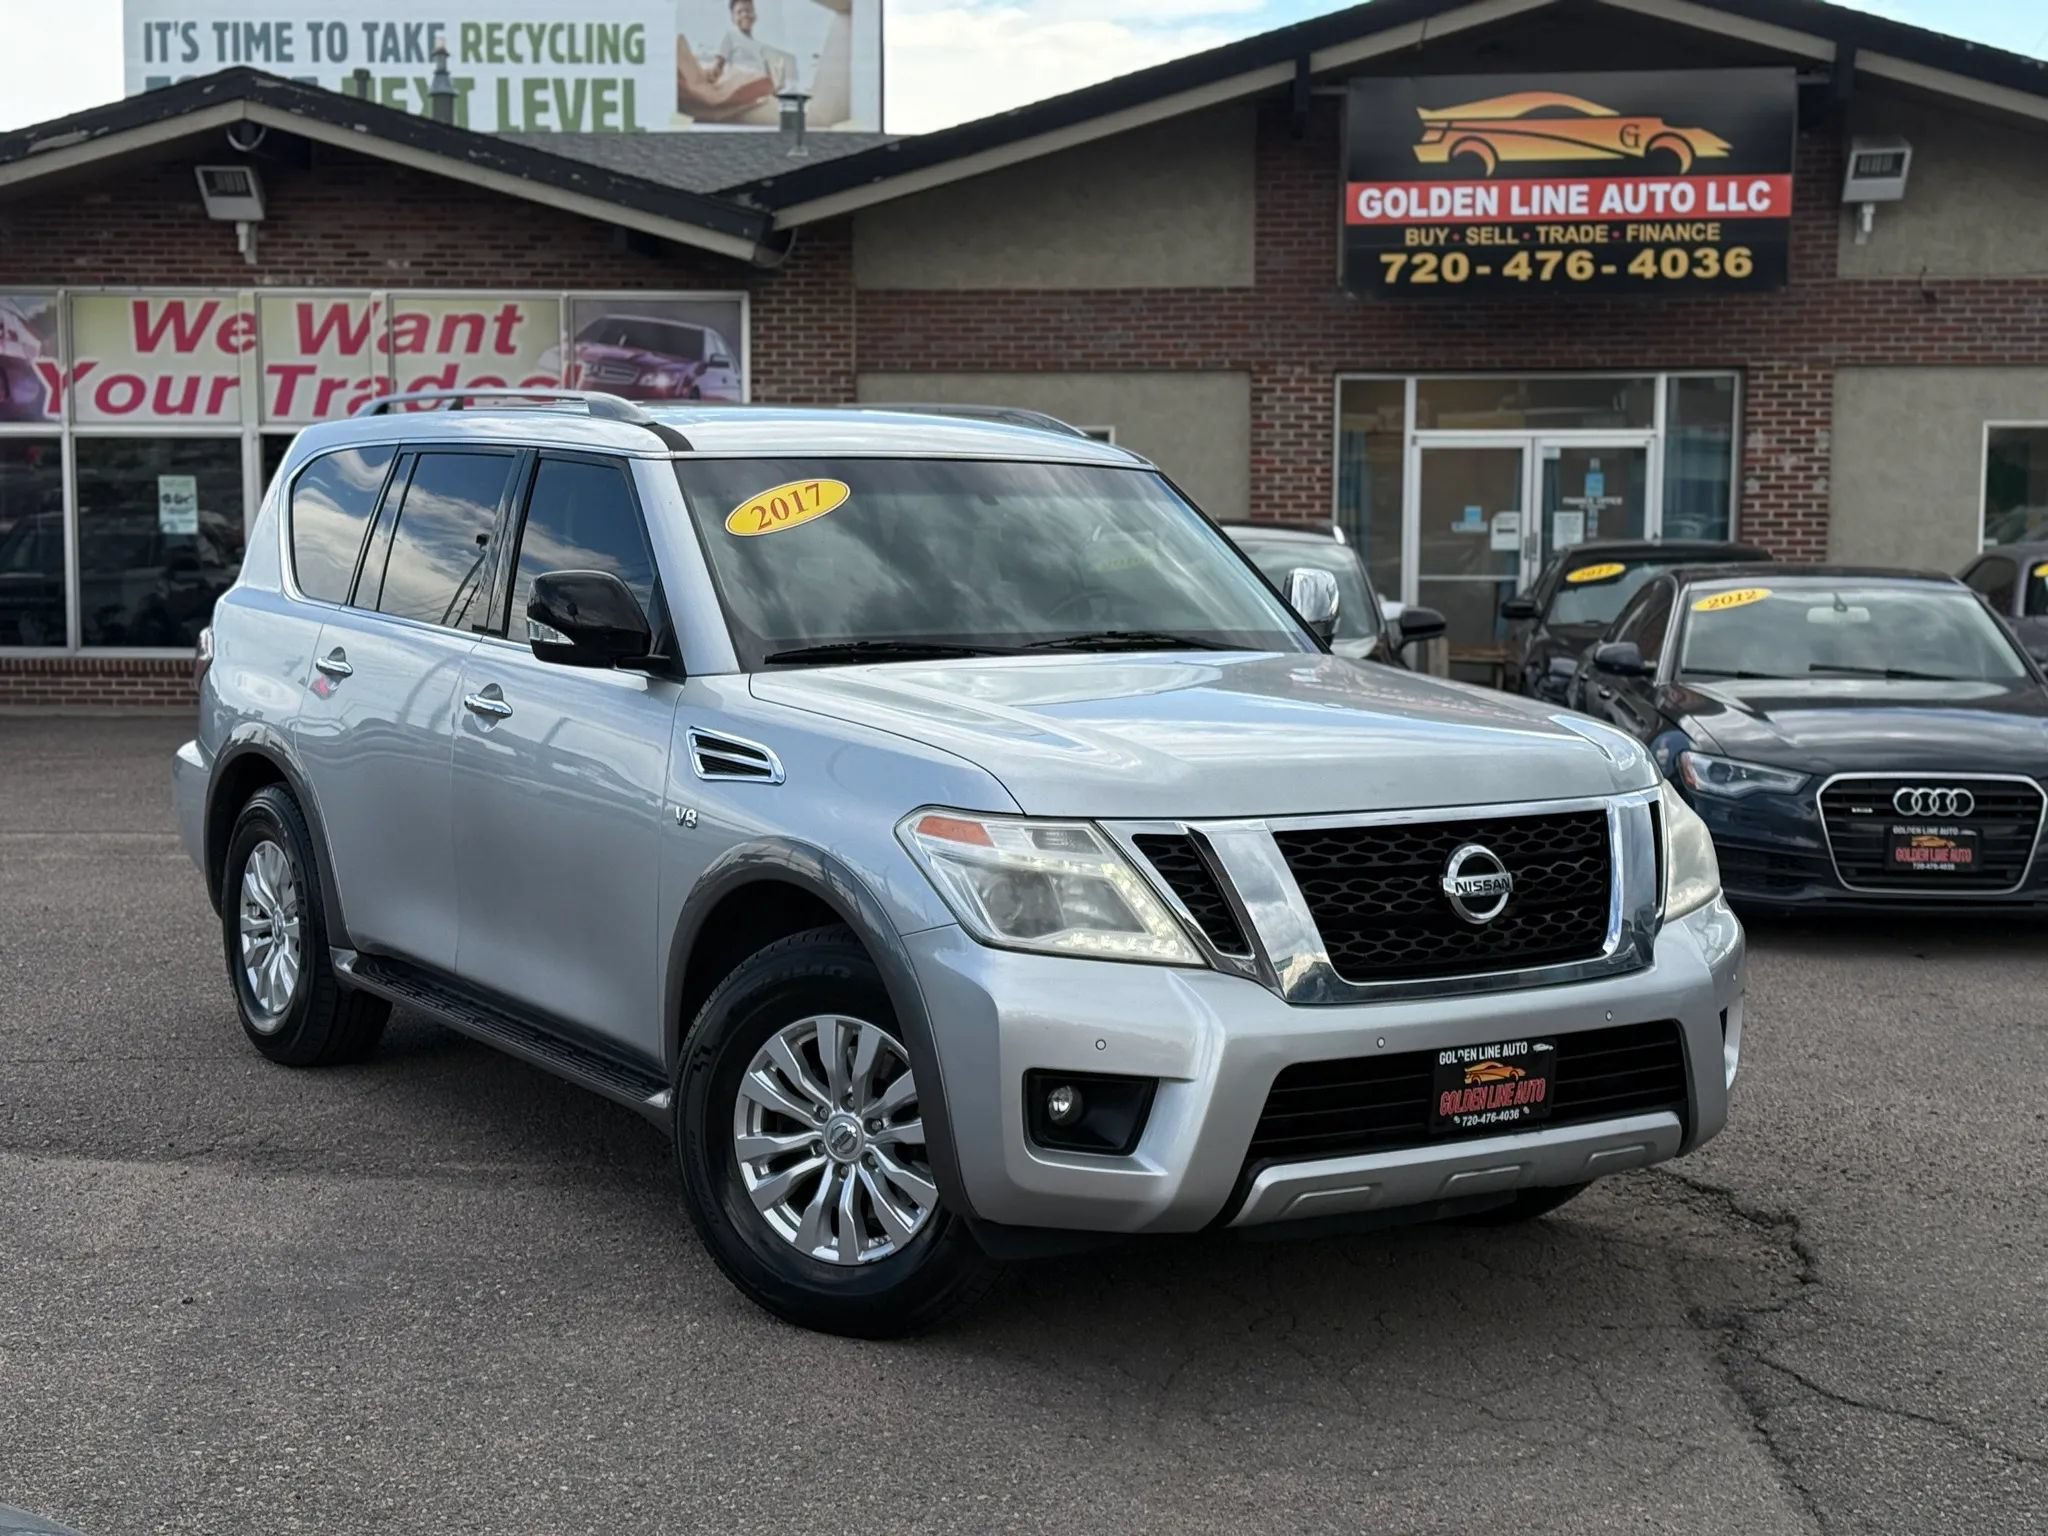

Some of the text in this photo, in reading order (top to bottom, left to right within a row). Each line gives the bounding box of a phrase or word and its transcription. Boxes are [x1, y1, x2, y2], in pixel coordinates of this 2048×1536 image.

[144, 21, 646, 65] IT'S TIME TO TAKE RECYCLING
[497, 77, 646, 132] LEVEL
[1358, 180, 1772, 218] GOLDEN LINE AUTO LLC
[1405, 222, 1721, 246] BUY SELL TRADE FINANCE
[132, 300, 524, 356] We Want
[36, 361, 241, 416] Your
[750, 482, 821, 531] 2017
[1708, 589, 1756, 609] 2012
[676, 806, 698, 829] V8
[1455, 878, 1510, 894] NISSAN
[1479, 1045, 1501, 1060] LINE
[1503, 1041, 1528, 1057] AUTO
[1440, 1078, 1546, 1116] GOLDEN LINE AUTO
[1462, 1109, 1520, 1127] 720-476-4036
